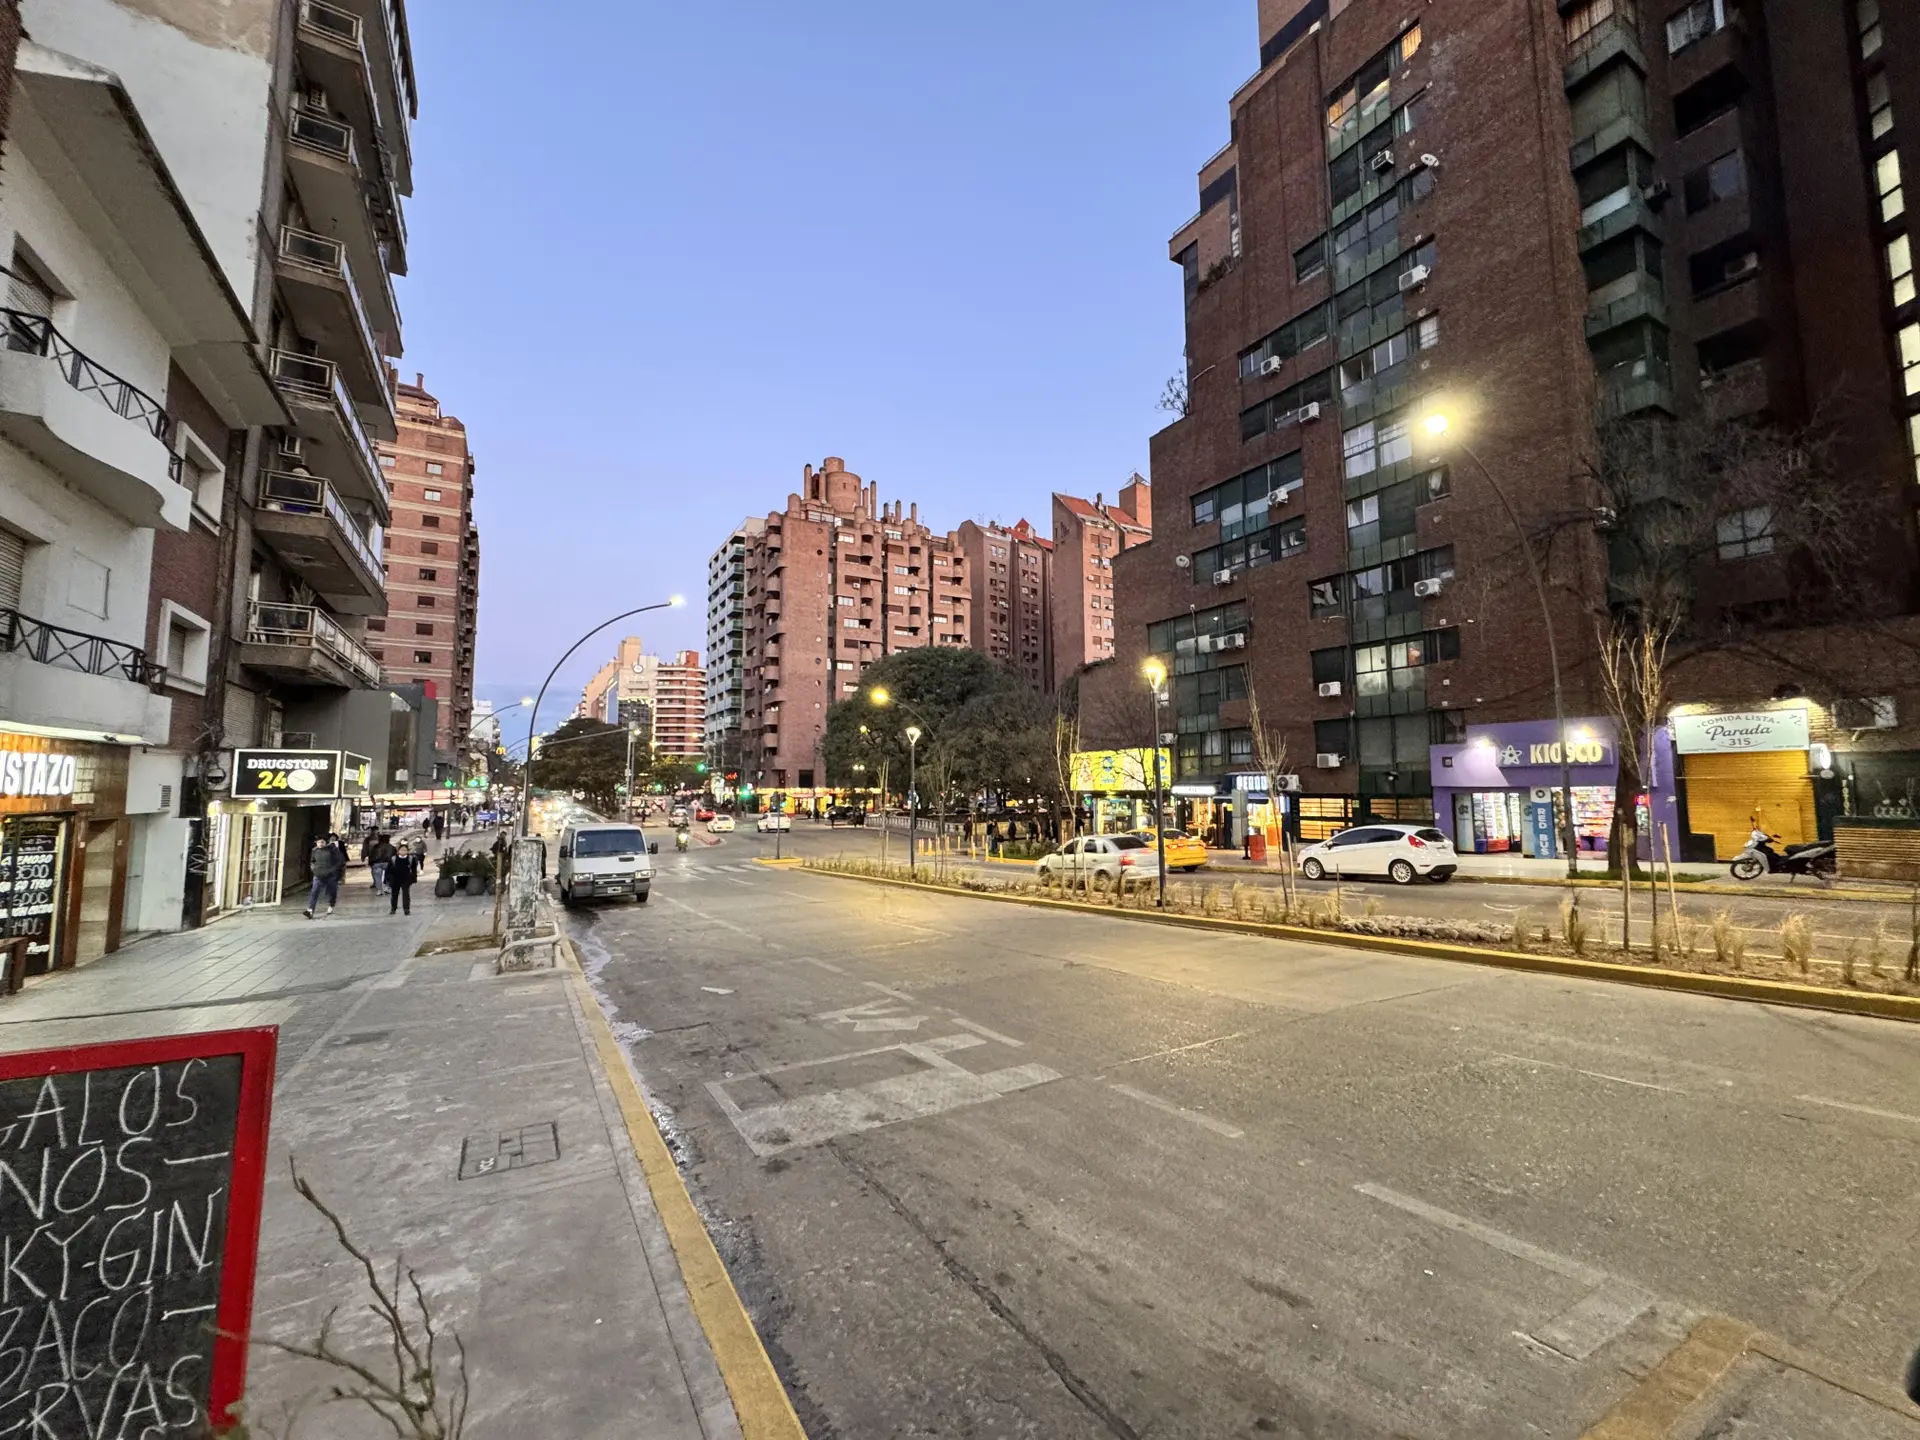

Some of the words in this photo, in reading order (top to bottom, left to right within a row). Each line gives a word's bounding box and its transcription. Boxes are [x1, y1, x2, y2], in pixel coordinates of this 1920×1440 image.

[1701, 715, 1741, 728] COMIDA
[1745, 715, 1776, 725] LISTA
[1705, 724, 1772, 741] Parada
[1728, 738, 1751, 746] 315
[1530, 742, 1603, 764] KIOSCO
[0, 750, 75, 796] STAZO
[247, 759, 329, 770] DRUGSTORE
[258, 770, 288, 789] 24
[1537, 808, 1548, 829] RED
[1539, 834, 1550, 855] BUS
[0, 1058, 207, 1149] ALOS
